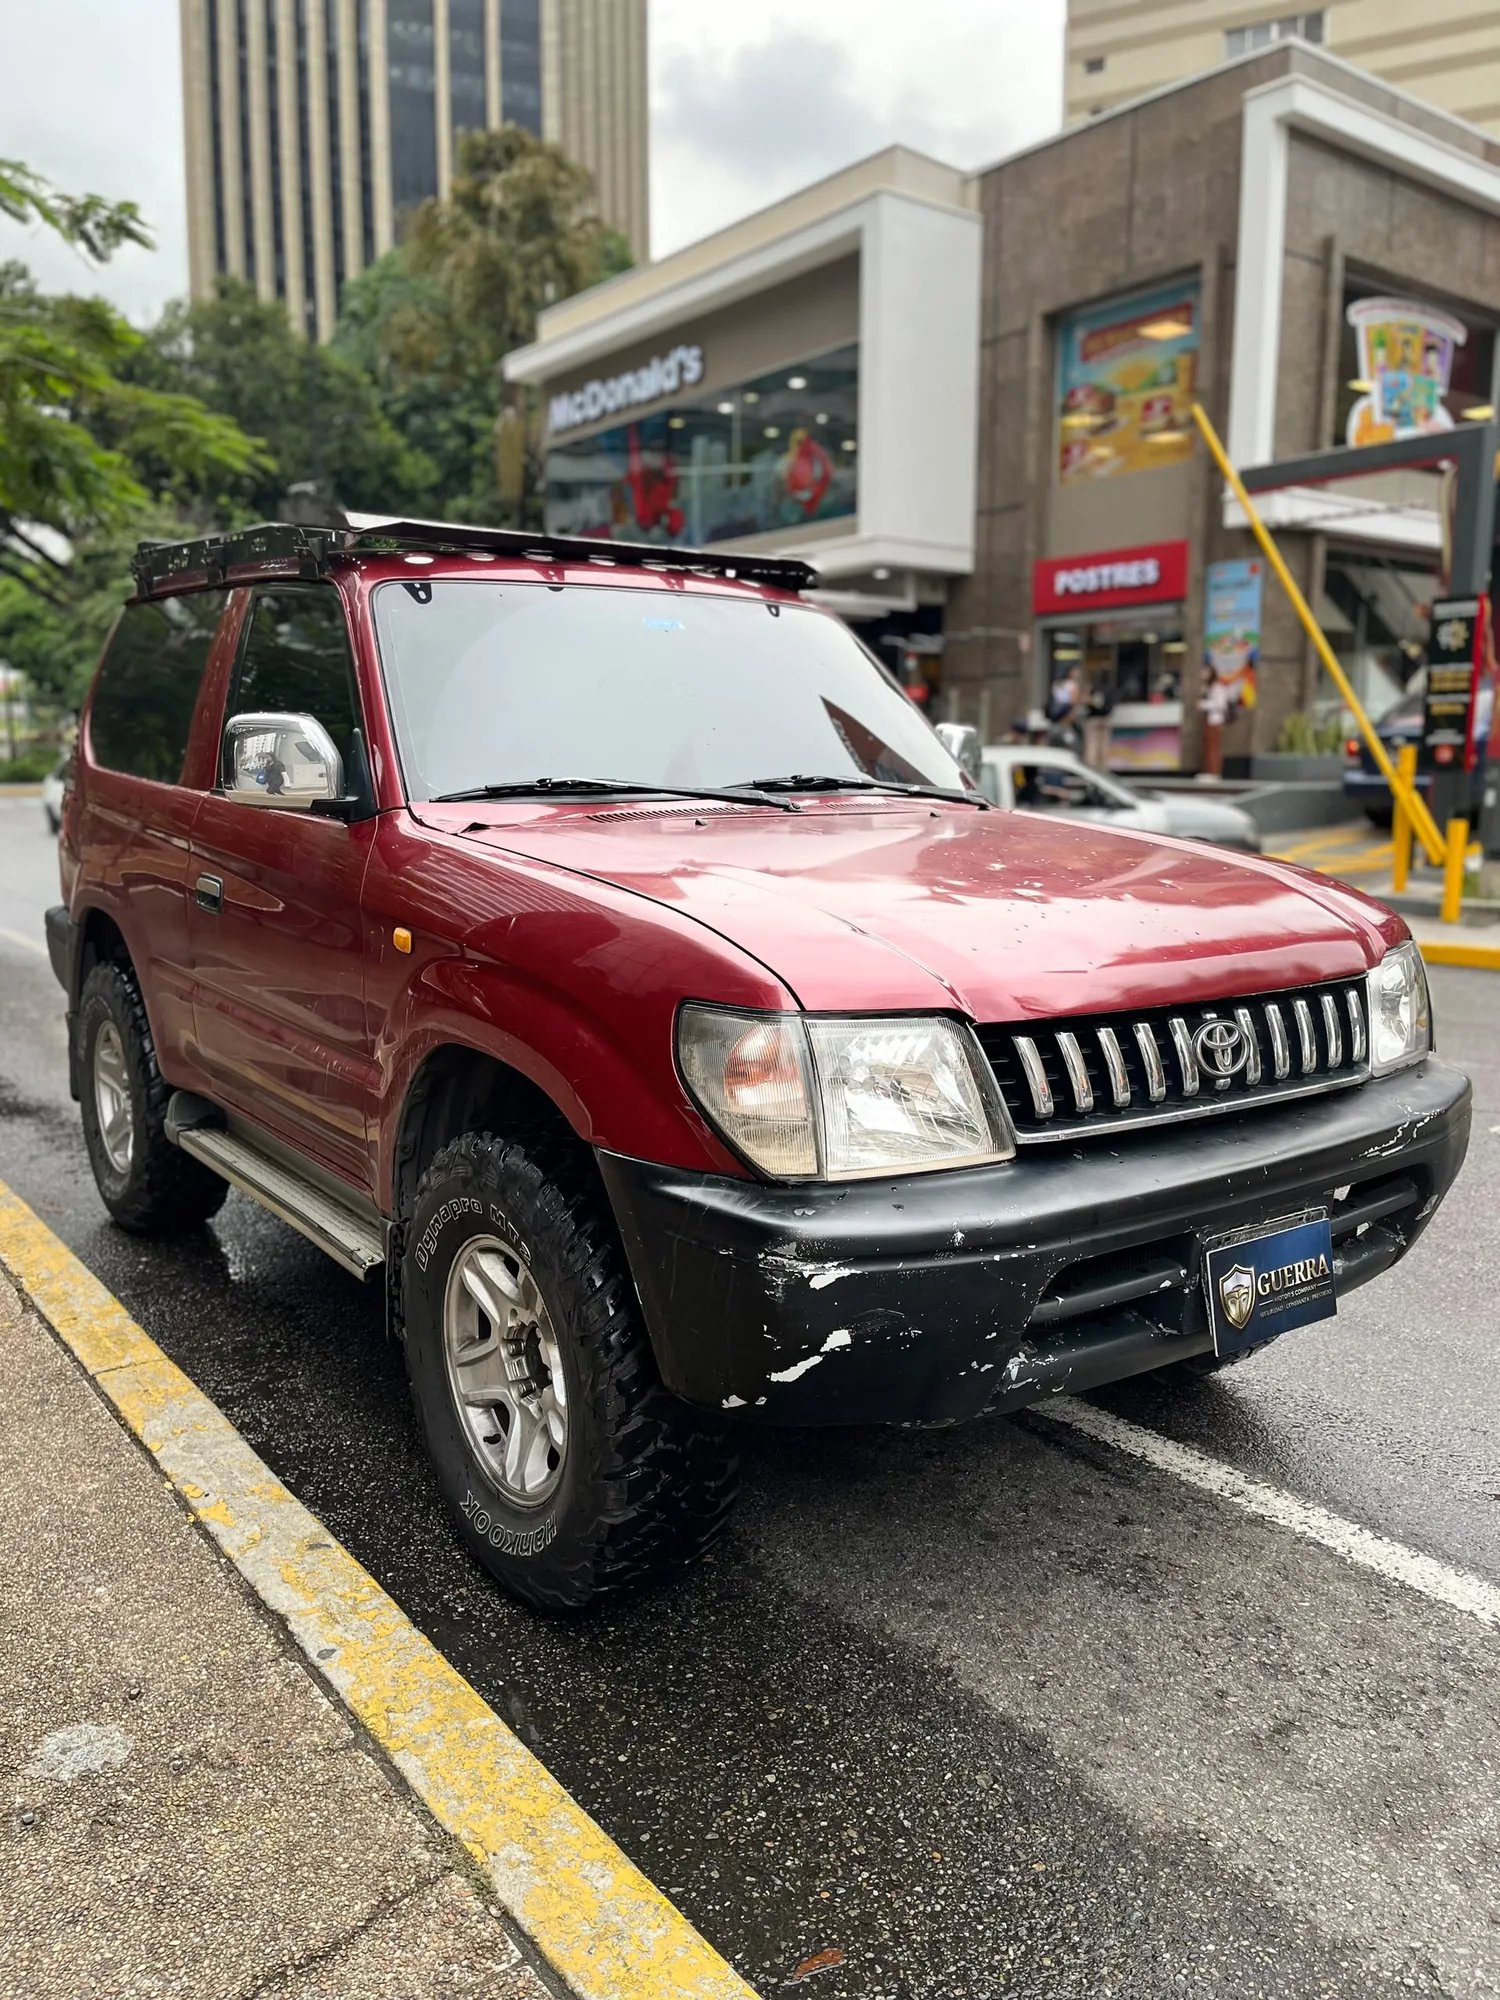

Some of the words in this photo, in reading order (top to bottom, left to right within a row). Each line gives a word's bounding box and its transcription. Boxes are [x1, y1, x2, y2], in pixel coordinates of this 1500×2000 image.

[549, 344, 704, 434] McDonald's
[1054, 557, 1160, 596] POSTRES
[415, 1197, 483, 1272] Dynapro
[1257, 1253, 1330, 1295] GUERRA
[1294, 1283, 1317, 1296] COMPANY
